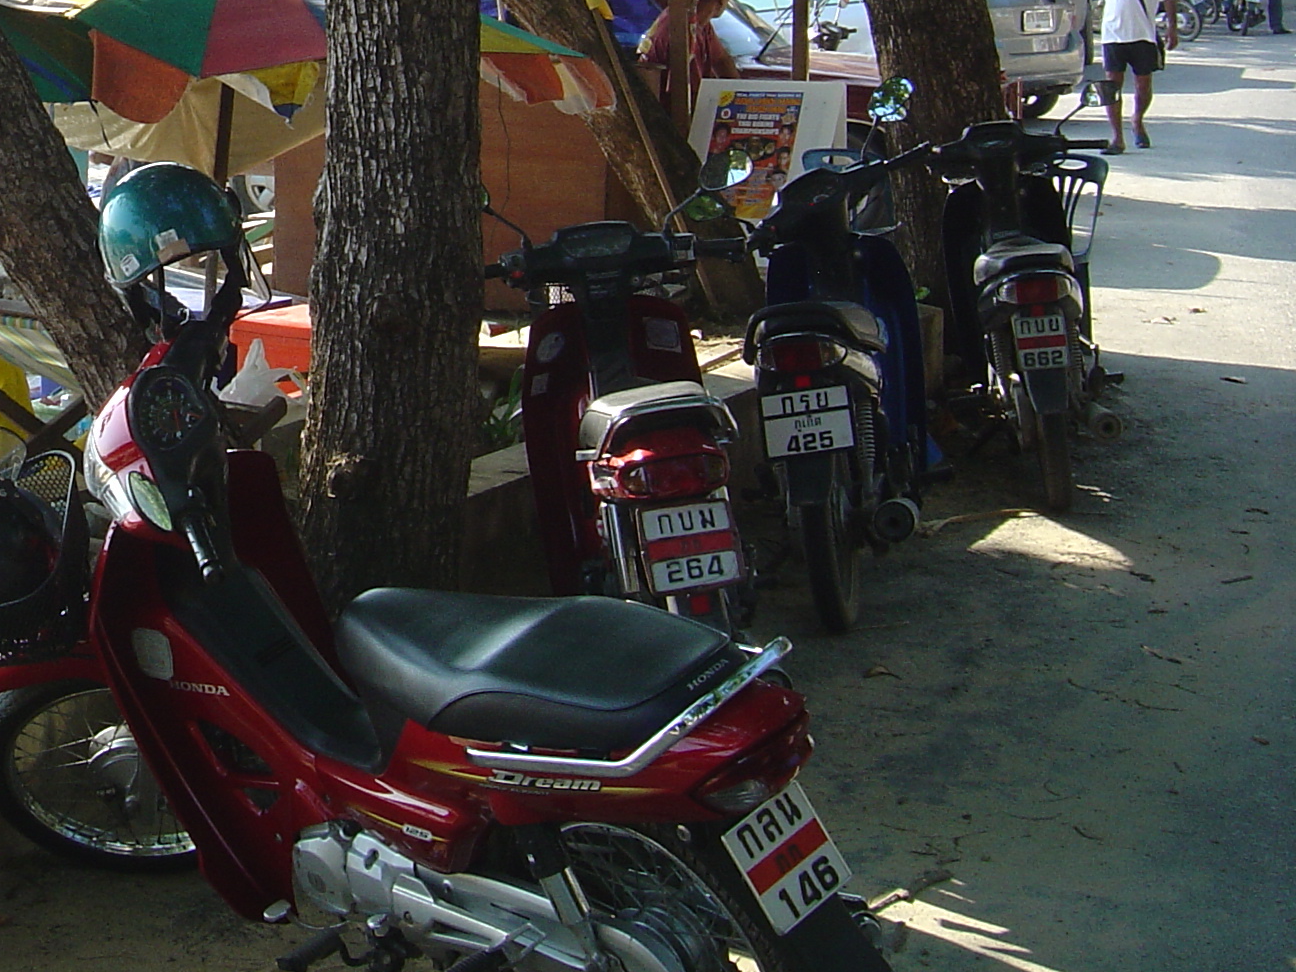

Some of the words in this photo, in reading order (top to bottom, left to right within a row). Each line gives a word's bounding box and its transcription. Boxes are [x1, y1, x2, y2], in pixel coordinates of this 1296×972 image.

[1024, 350, 1064, 367] 662
[787, 430, 834, 453] 425
[666, 555, 724, 584] 264
[686, 658, 729, 691] HONDA
[170, 680, 231, 697] HONDA
[487, 768, 602, 791] Dream
[736, 792, 802, 859] กลน
[778, 855, 840, 920] 146
